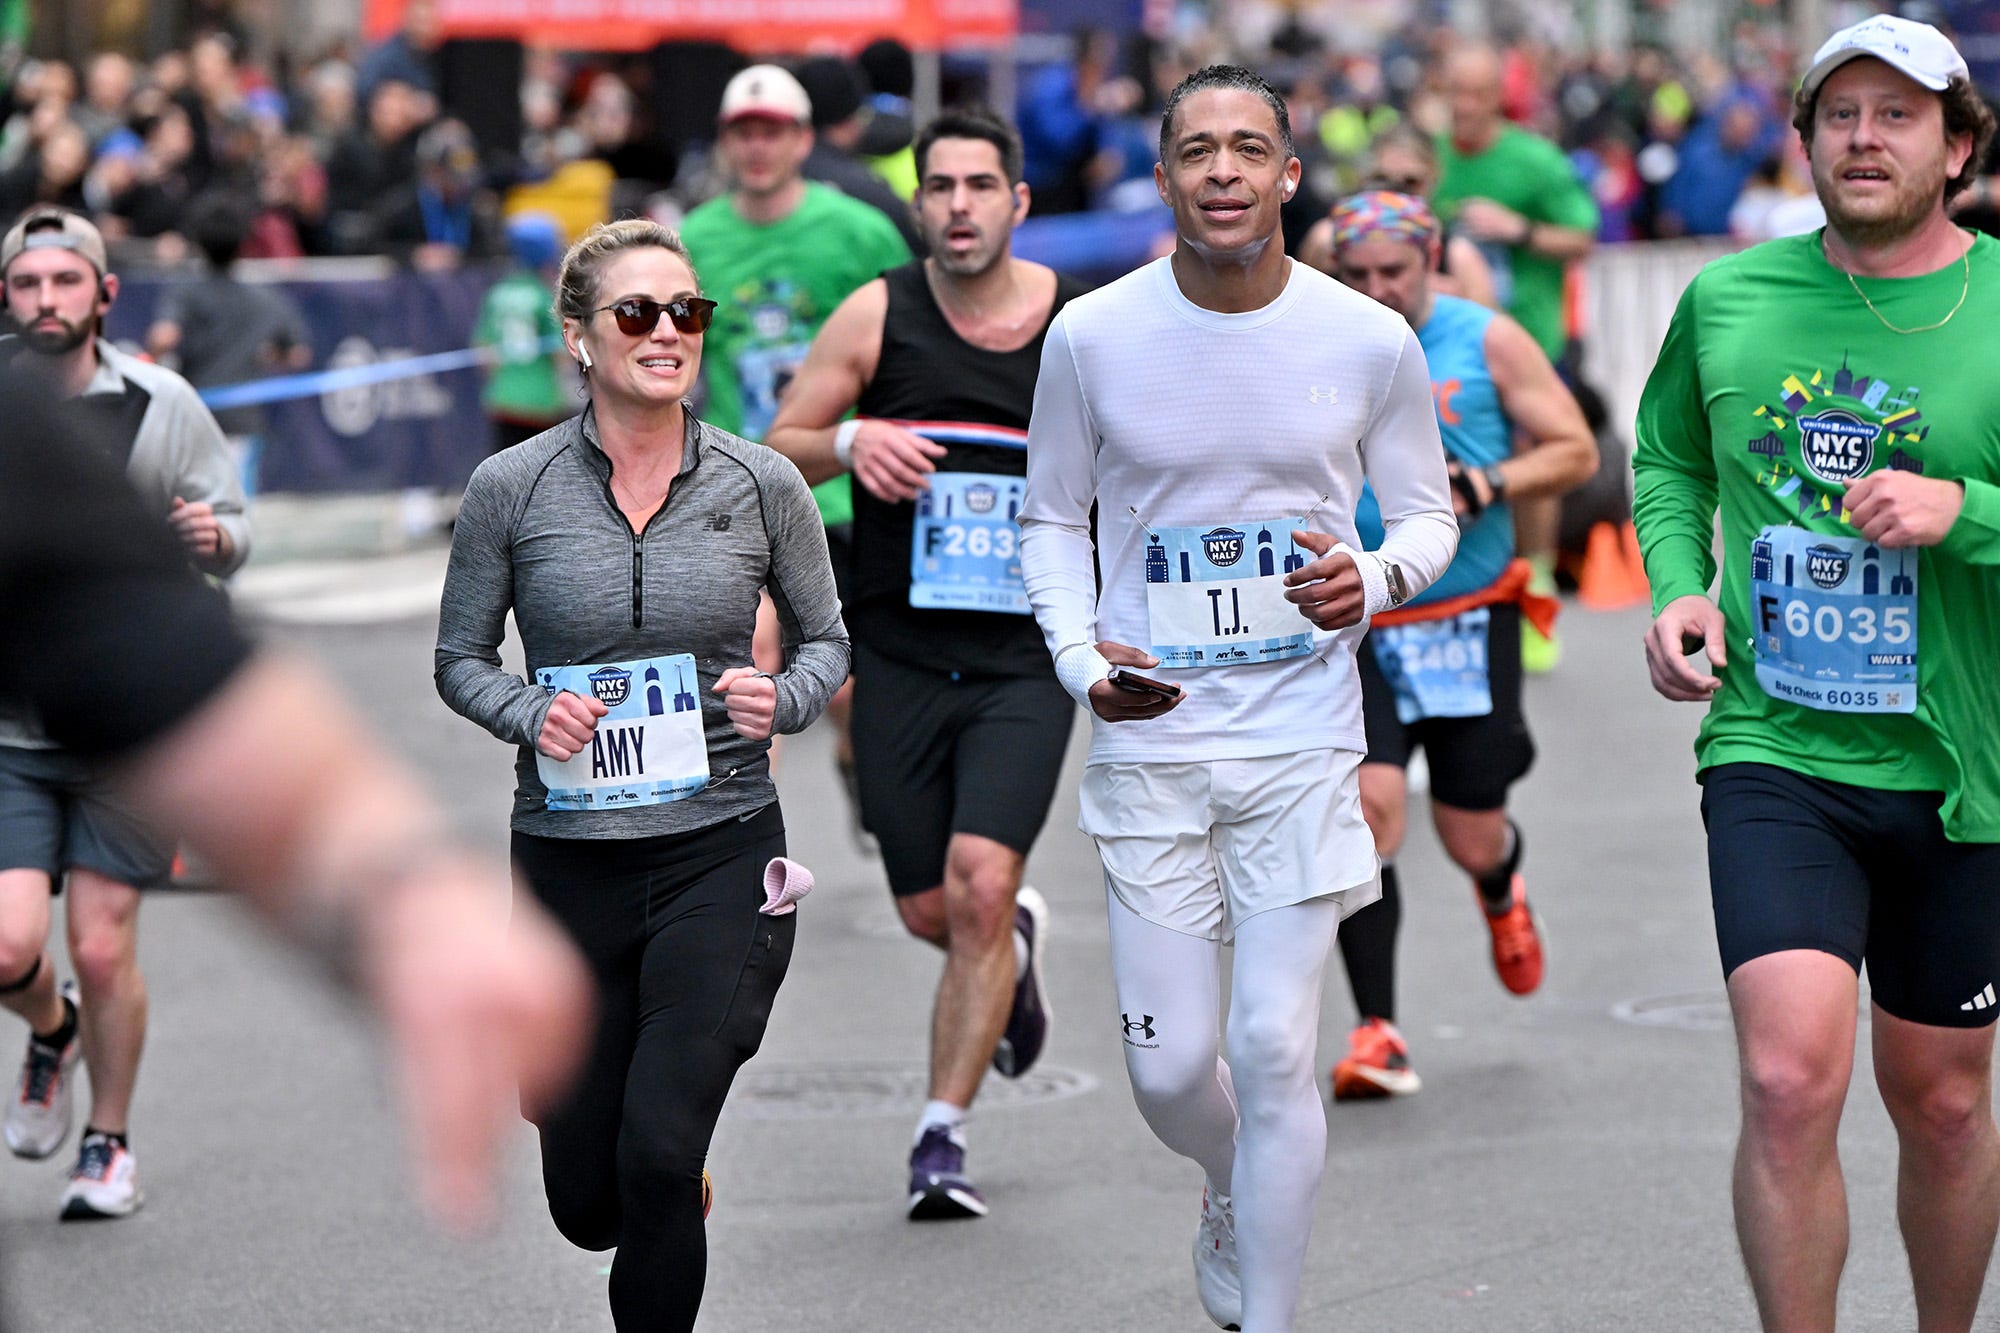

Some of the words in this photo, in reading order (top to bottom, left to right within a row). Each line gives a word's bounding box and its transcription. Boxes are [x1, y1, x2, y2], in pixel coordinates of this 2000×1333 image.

[1803, 421, 1832, 430] UNITED
[1840, 425, 1874, 435] AIRLINES
[1812, 432, 1862, 457] NYC
[1815, 453, 1858, 471] HALF
[926, 525, 1021, 560] F263
[1210, 540, 1238, 552] NYC
[1212, 551, 1236, 560] HALF
[1811, 557, 1843, 572] NYC
[1813, 570, 1840, 582] HALF
[1207, 587, 1249, 636] T.J.
[1871, 655, 1903, 665] WAVE
[1905, 655, 1912, 665] 1
[596, 679, 625, 692] NYC
[599, 691, 624, 700] HALF
[1775, 680, 1793, 696] Bag
[1794, 683, 1823, 702] Check
[1827, 690, 1879, 706] 6035
[592, 726, 645, 779] AMY
